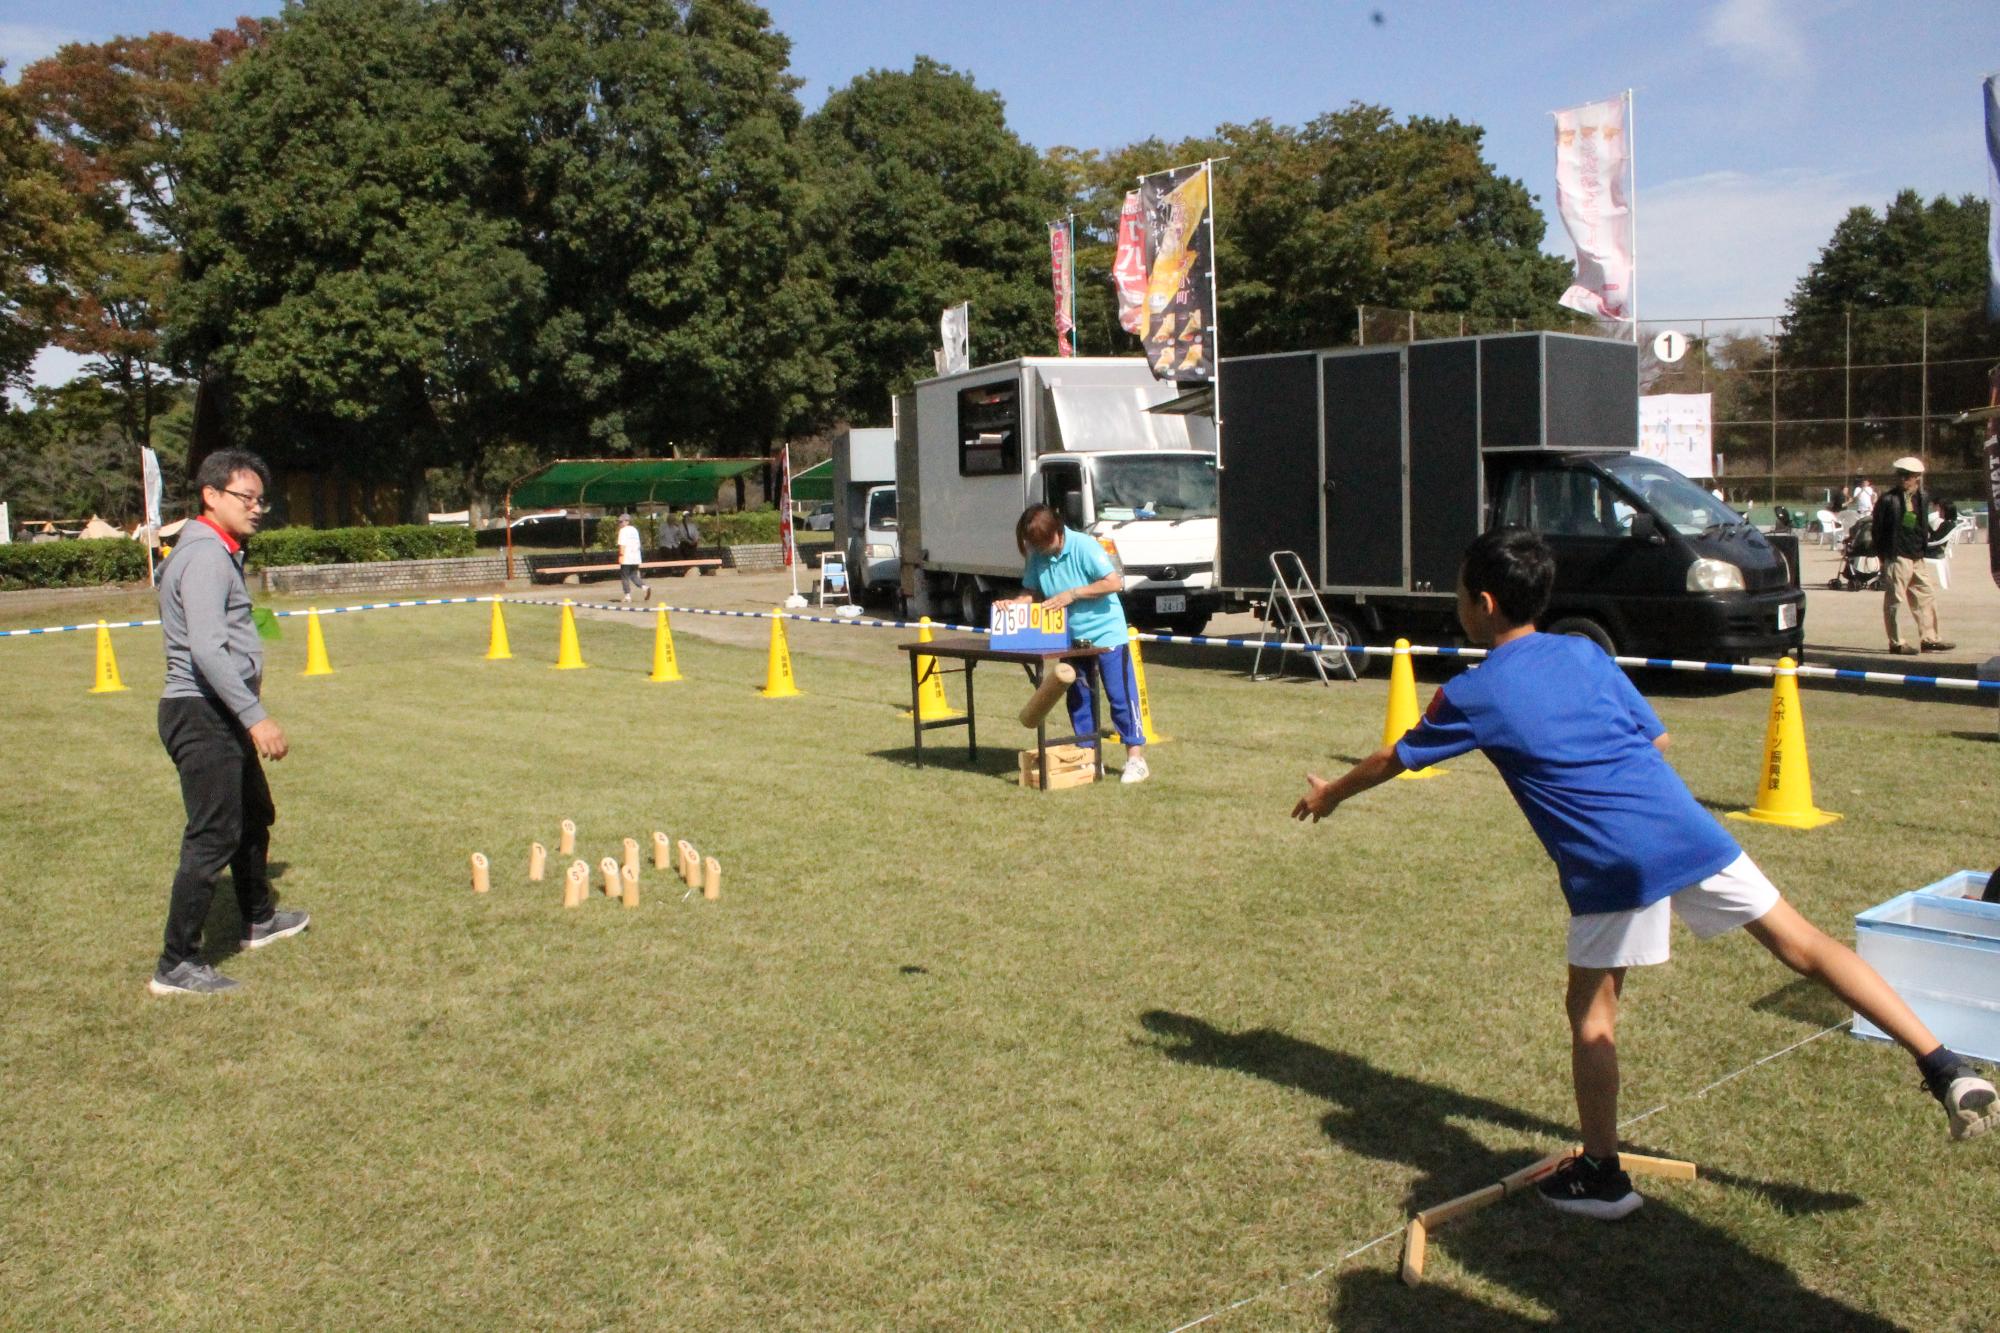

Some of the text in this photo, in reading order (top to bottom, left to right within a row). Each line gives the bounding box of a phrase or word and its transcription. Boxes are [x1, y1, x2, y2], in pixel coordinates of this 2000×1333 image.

[1663, 334, 1673, 359] 1
[1768, 696, 1785, 790] スポーツ振興課
